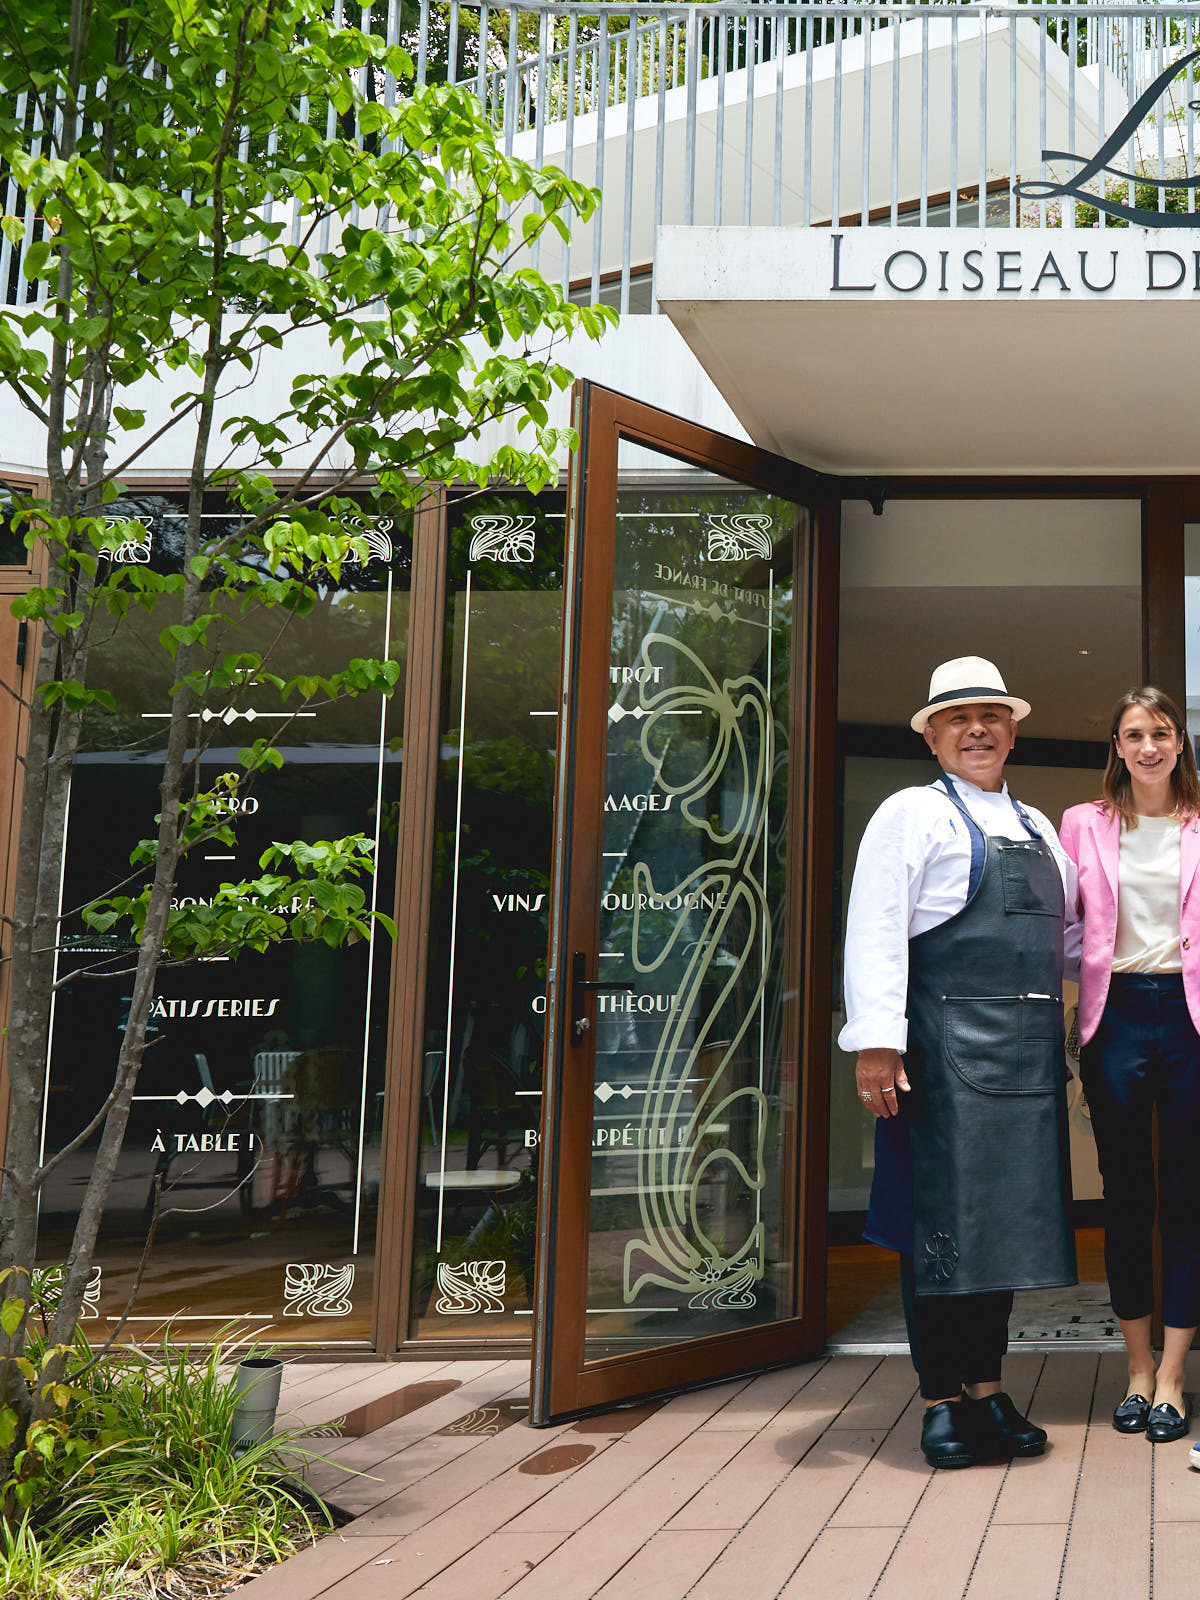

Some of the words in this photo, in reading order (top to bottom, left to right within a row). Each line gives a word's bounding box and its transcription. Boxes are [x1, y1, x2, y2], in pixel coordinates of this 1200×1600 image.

[830, 234, 1119, 292] LOISEAU
[609, 666, 664, 684] TROT
[604, 794, 676, 812] MAGES
[492, 894, 546, 912] VINS
[603, 892, 728, 911] OURGOGNE
[150, 1128, 166, 1152] À
[174, 1133, 241, 1152] TABLE
[248, 1133, 254, 1151] !
[592, 1123, 667, 1146] PPÉTIT
